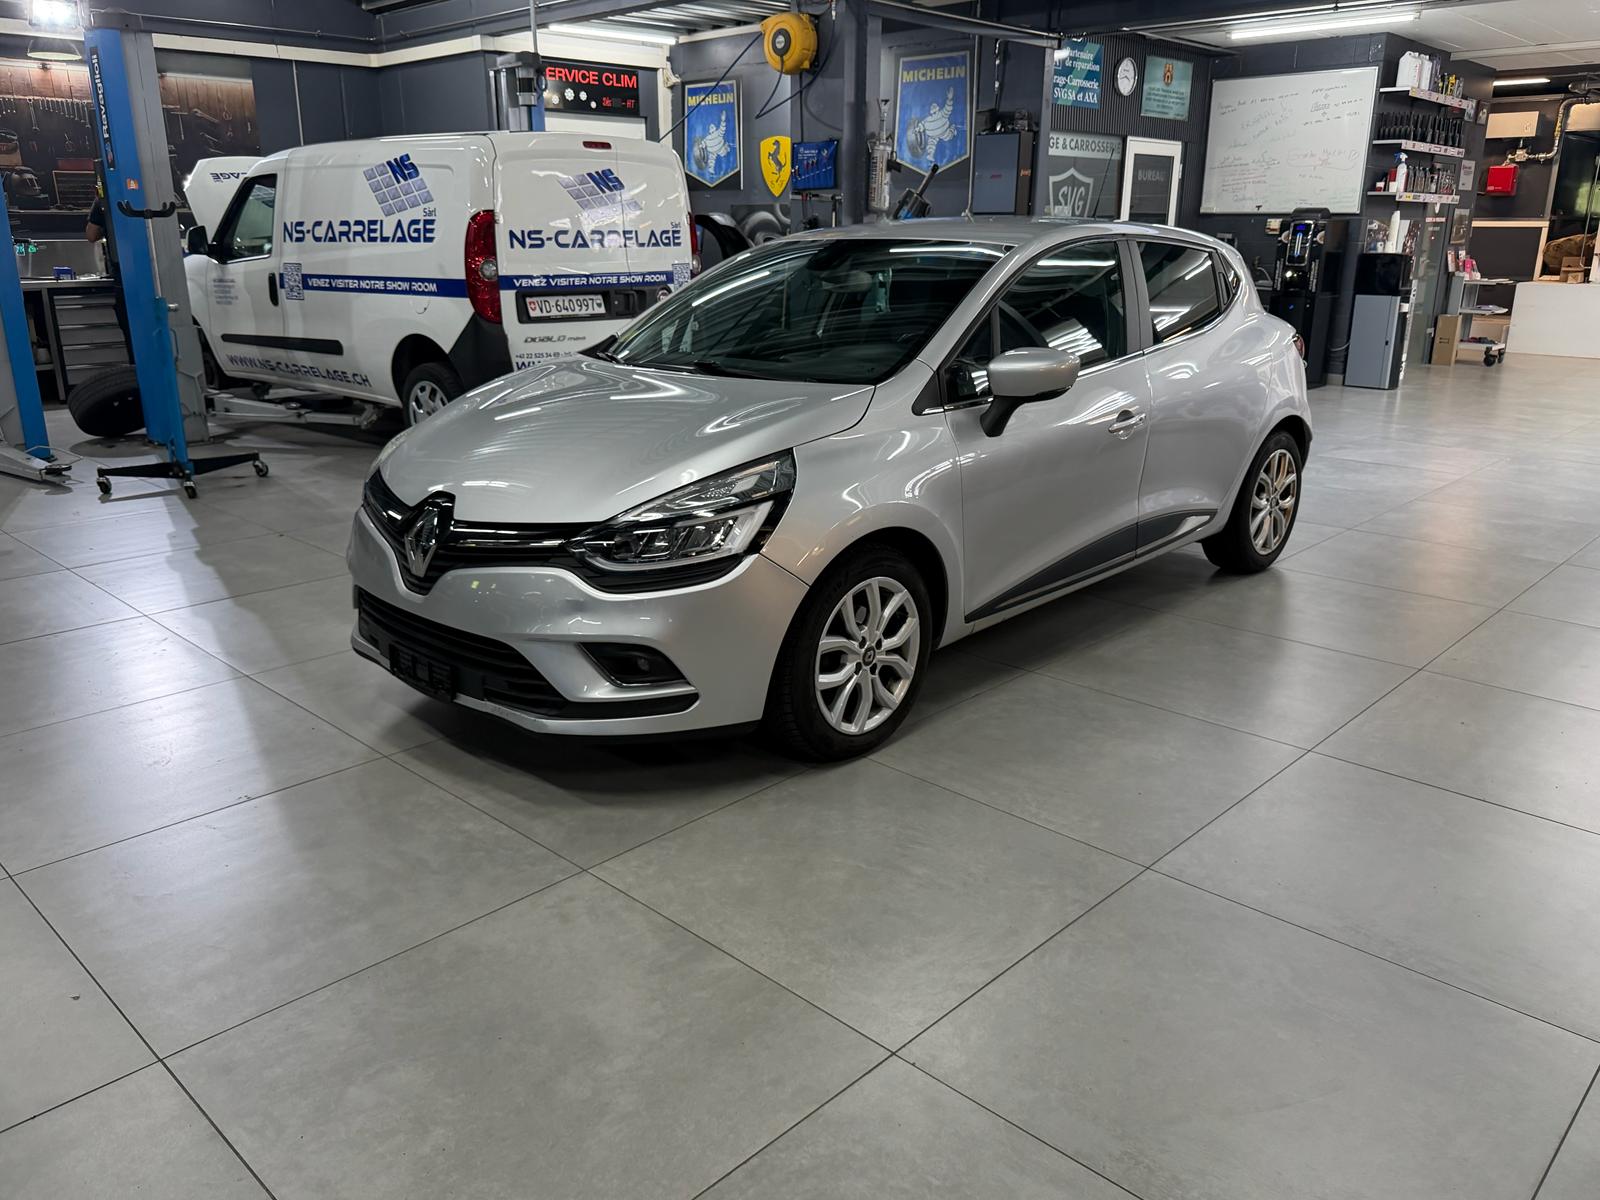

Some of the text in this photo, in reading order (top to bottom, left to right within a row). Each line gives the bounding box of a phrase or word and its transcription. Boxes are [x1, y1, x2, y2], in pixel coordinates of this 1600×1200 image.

[1065, 57, 1072, 67] de
[545, 66, 638, 89] ERVICE CLIM
[902, 66, 965, 83] MICHELIN
[1053, 74, 1099, 89] rage-Carrosserie
[91, 54, 109, 138] Ravaglioli
[687, 92, 735, 107] MICHELIN
[1084, 92, 1098, 103] AXA
[1062, 138, 1068, 150] &
[1069, 138, 1121, 154] CARROSSERIE
[386, 153, 420, 184] NS
[586, 168, 625, 193] NS
[1058, 185, 1086, 216] SVG
[283, 218, 437, 243] NS-CARRELAGE
[307, 278, 438, 292] VENEZ VISITER NOTRE SHOW ROOM
[513, 274, 667, 287] VENEZ VISITER NOTRE SHOW ROOM
